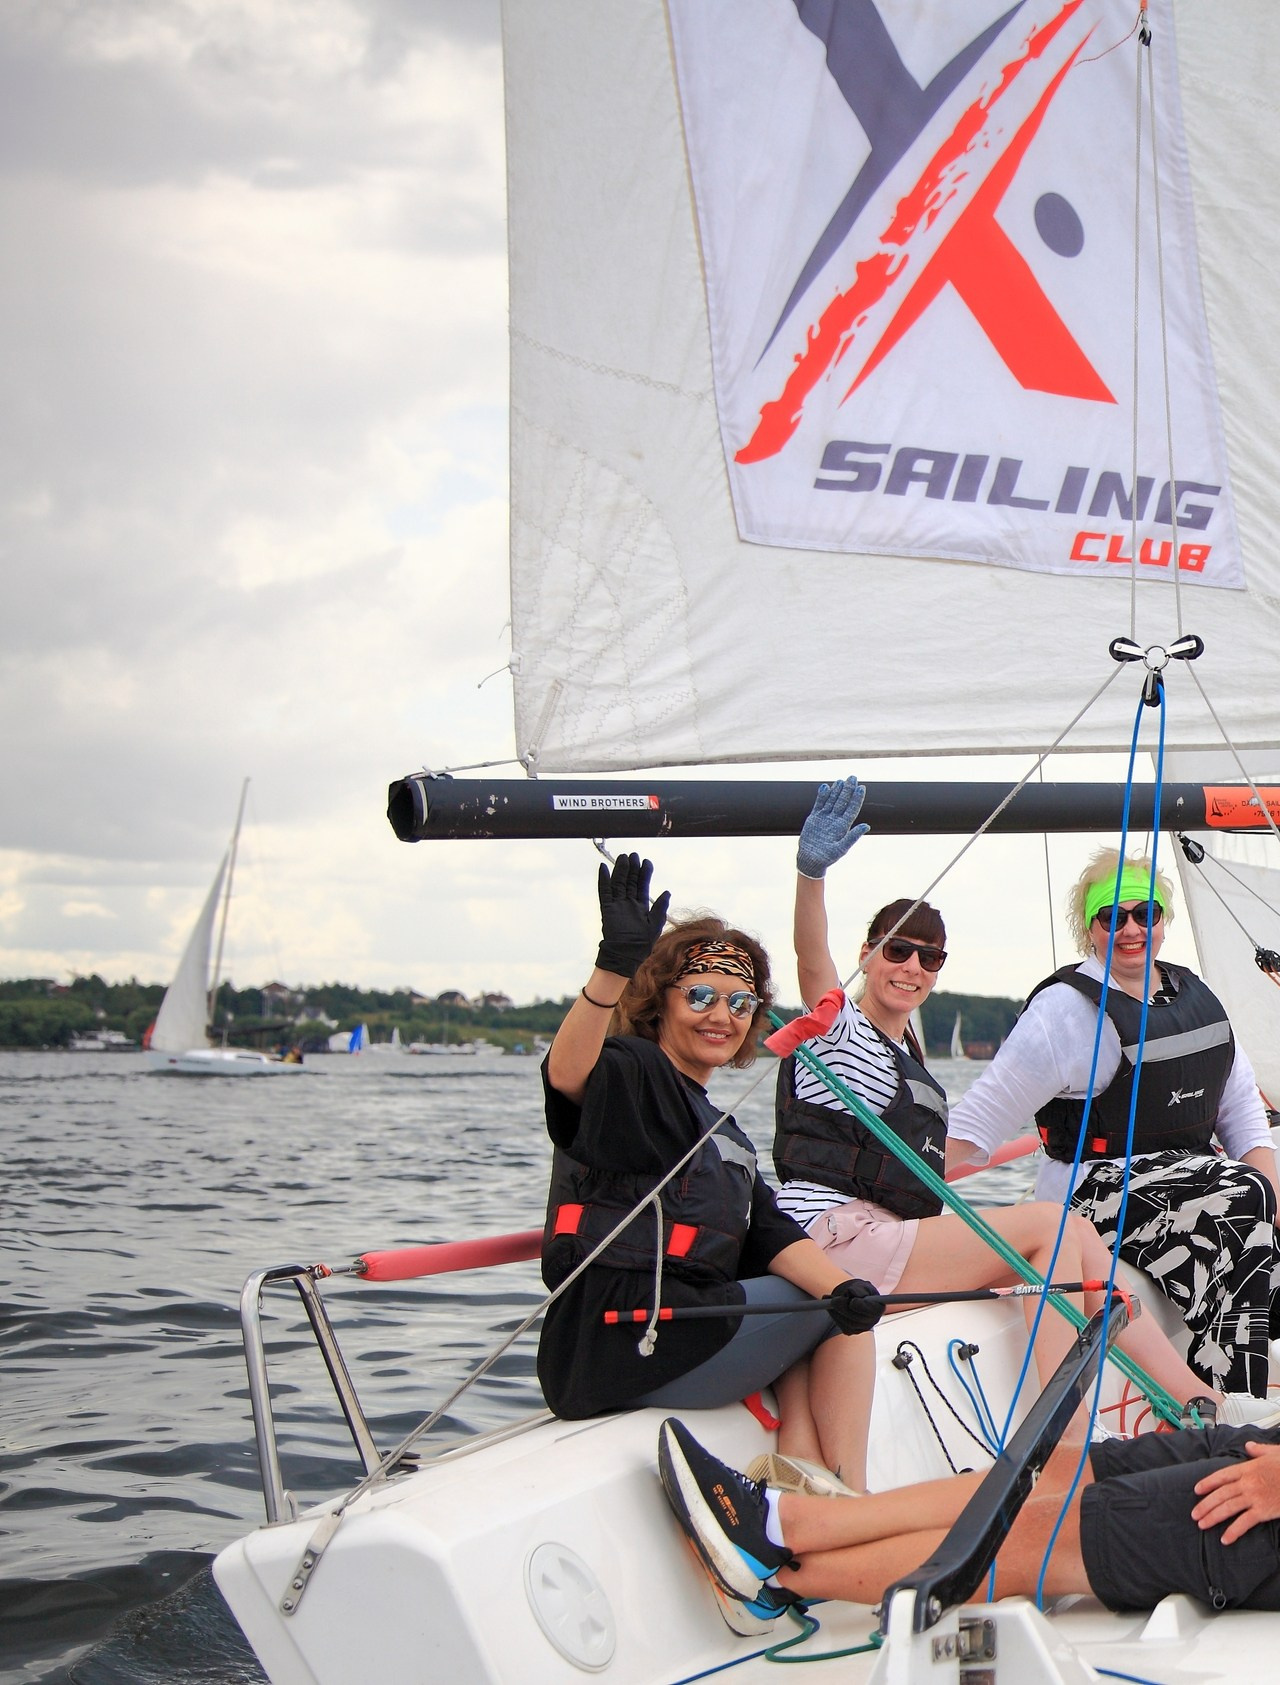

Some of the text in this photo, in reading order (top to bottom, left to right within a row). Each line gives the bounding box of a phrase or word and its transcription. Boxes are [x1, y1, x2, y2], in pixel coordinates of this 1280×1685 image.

[813, 440, 1222, 531] SAILING
[1069, 531, 1212, 572] CLUB
[558, 798, 645, 807] WIND BROTHERS
